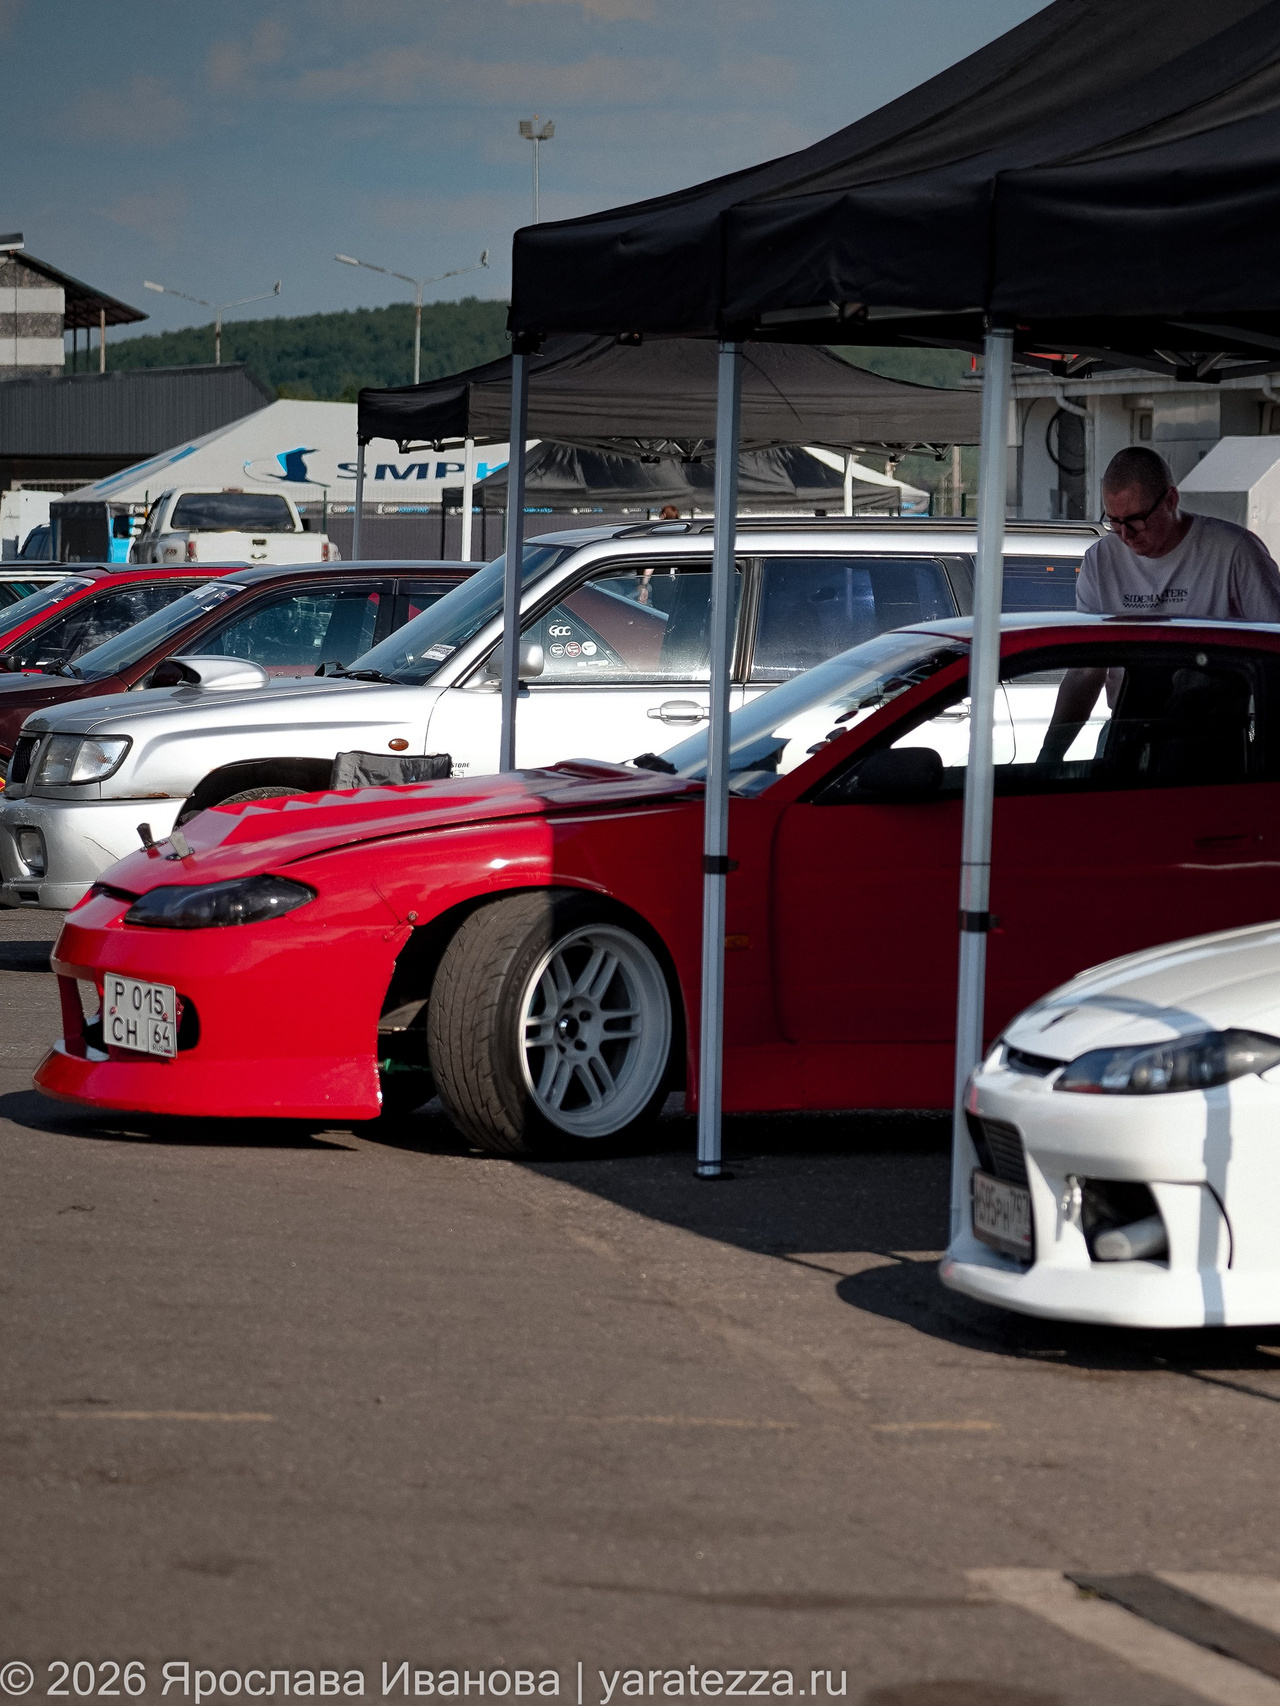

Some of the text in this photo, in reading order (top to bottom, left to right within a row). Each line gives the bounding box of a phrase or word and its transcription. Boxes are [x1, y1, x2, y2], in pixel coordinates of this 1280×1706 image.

[1124, 589, 1188, 603] SIDEMATERS
[133, 986, 164, 1015] 015
[153, 1024, 171, 1046] 64
